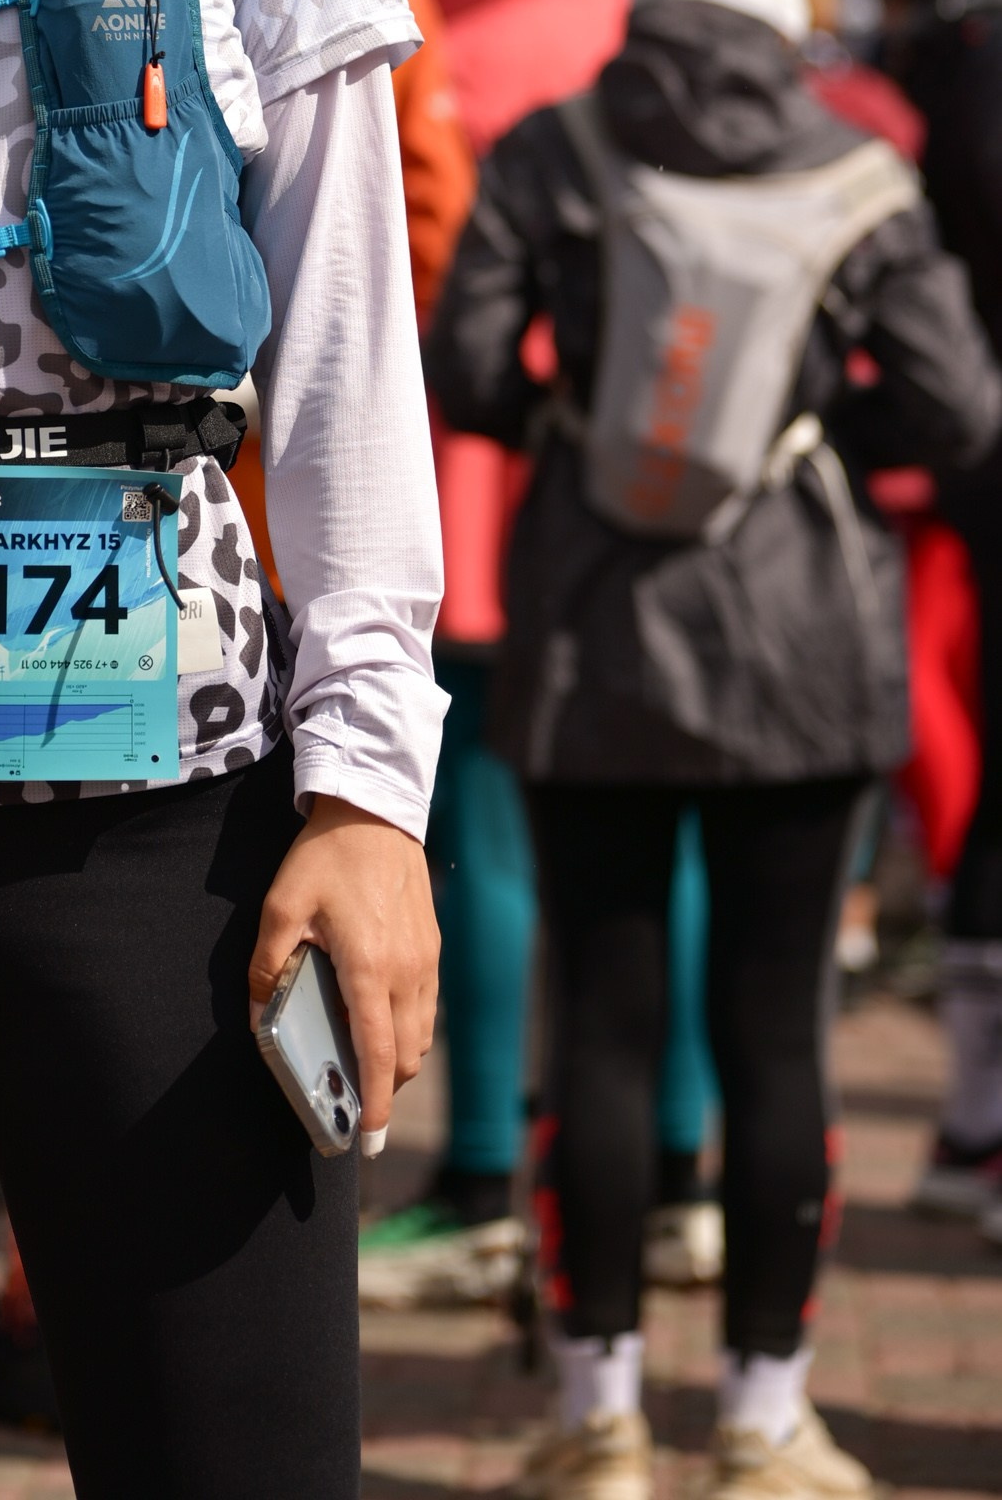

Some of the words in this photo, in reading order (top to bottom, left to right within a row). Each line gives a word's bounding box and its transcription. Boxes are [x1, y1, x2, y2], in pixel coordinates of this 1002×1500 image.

[98, 533, 121, 550] 15
[21, 660, 30, 669] 11
[31, 660, 48, 669] 00
[50, 660, 71, 669] 444
[73, 660, 93, 669] 925
[95, 660, 108, 669] +7
